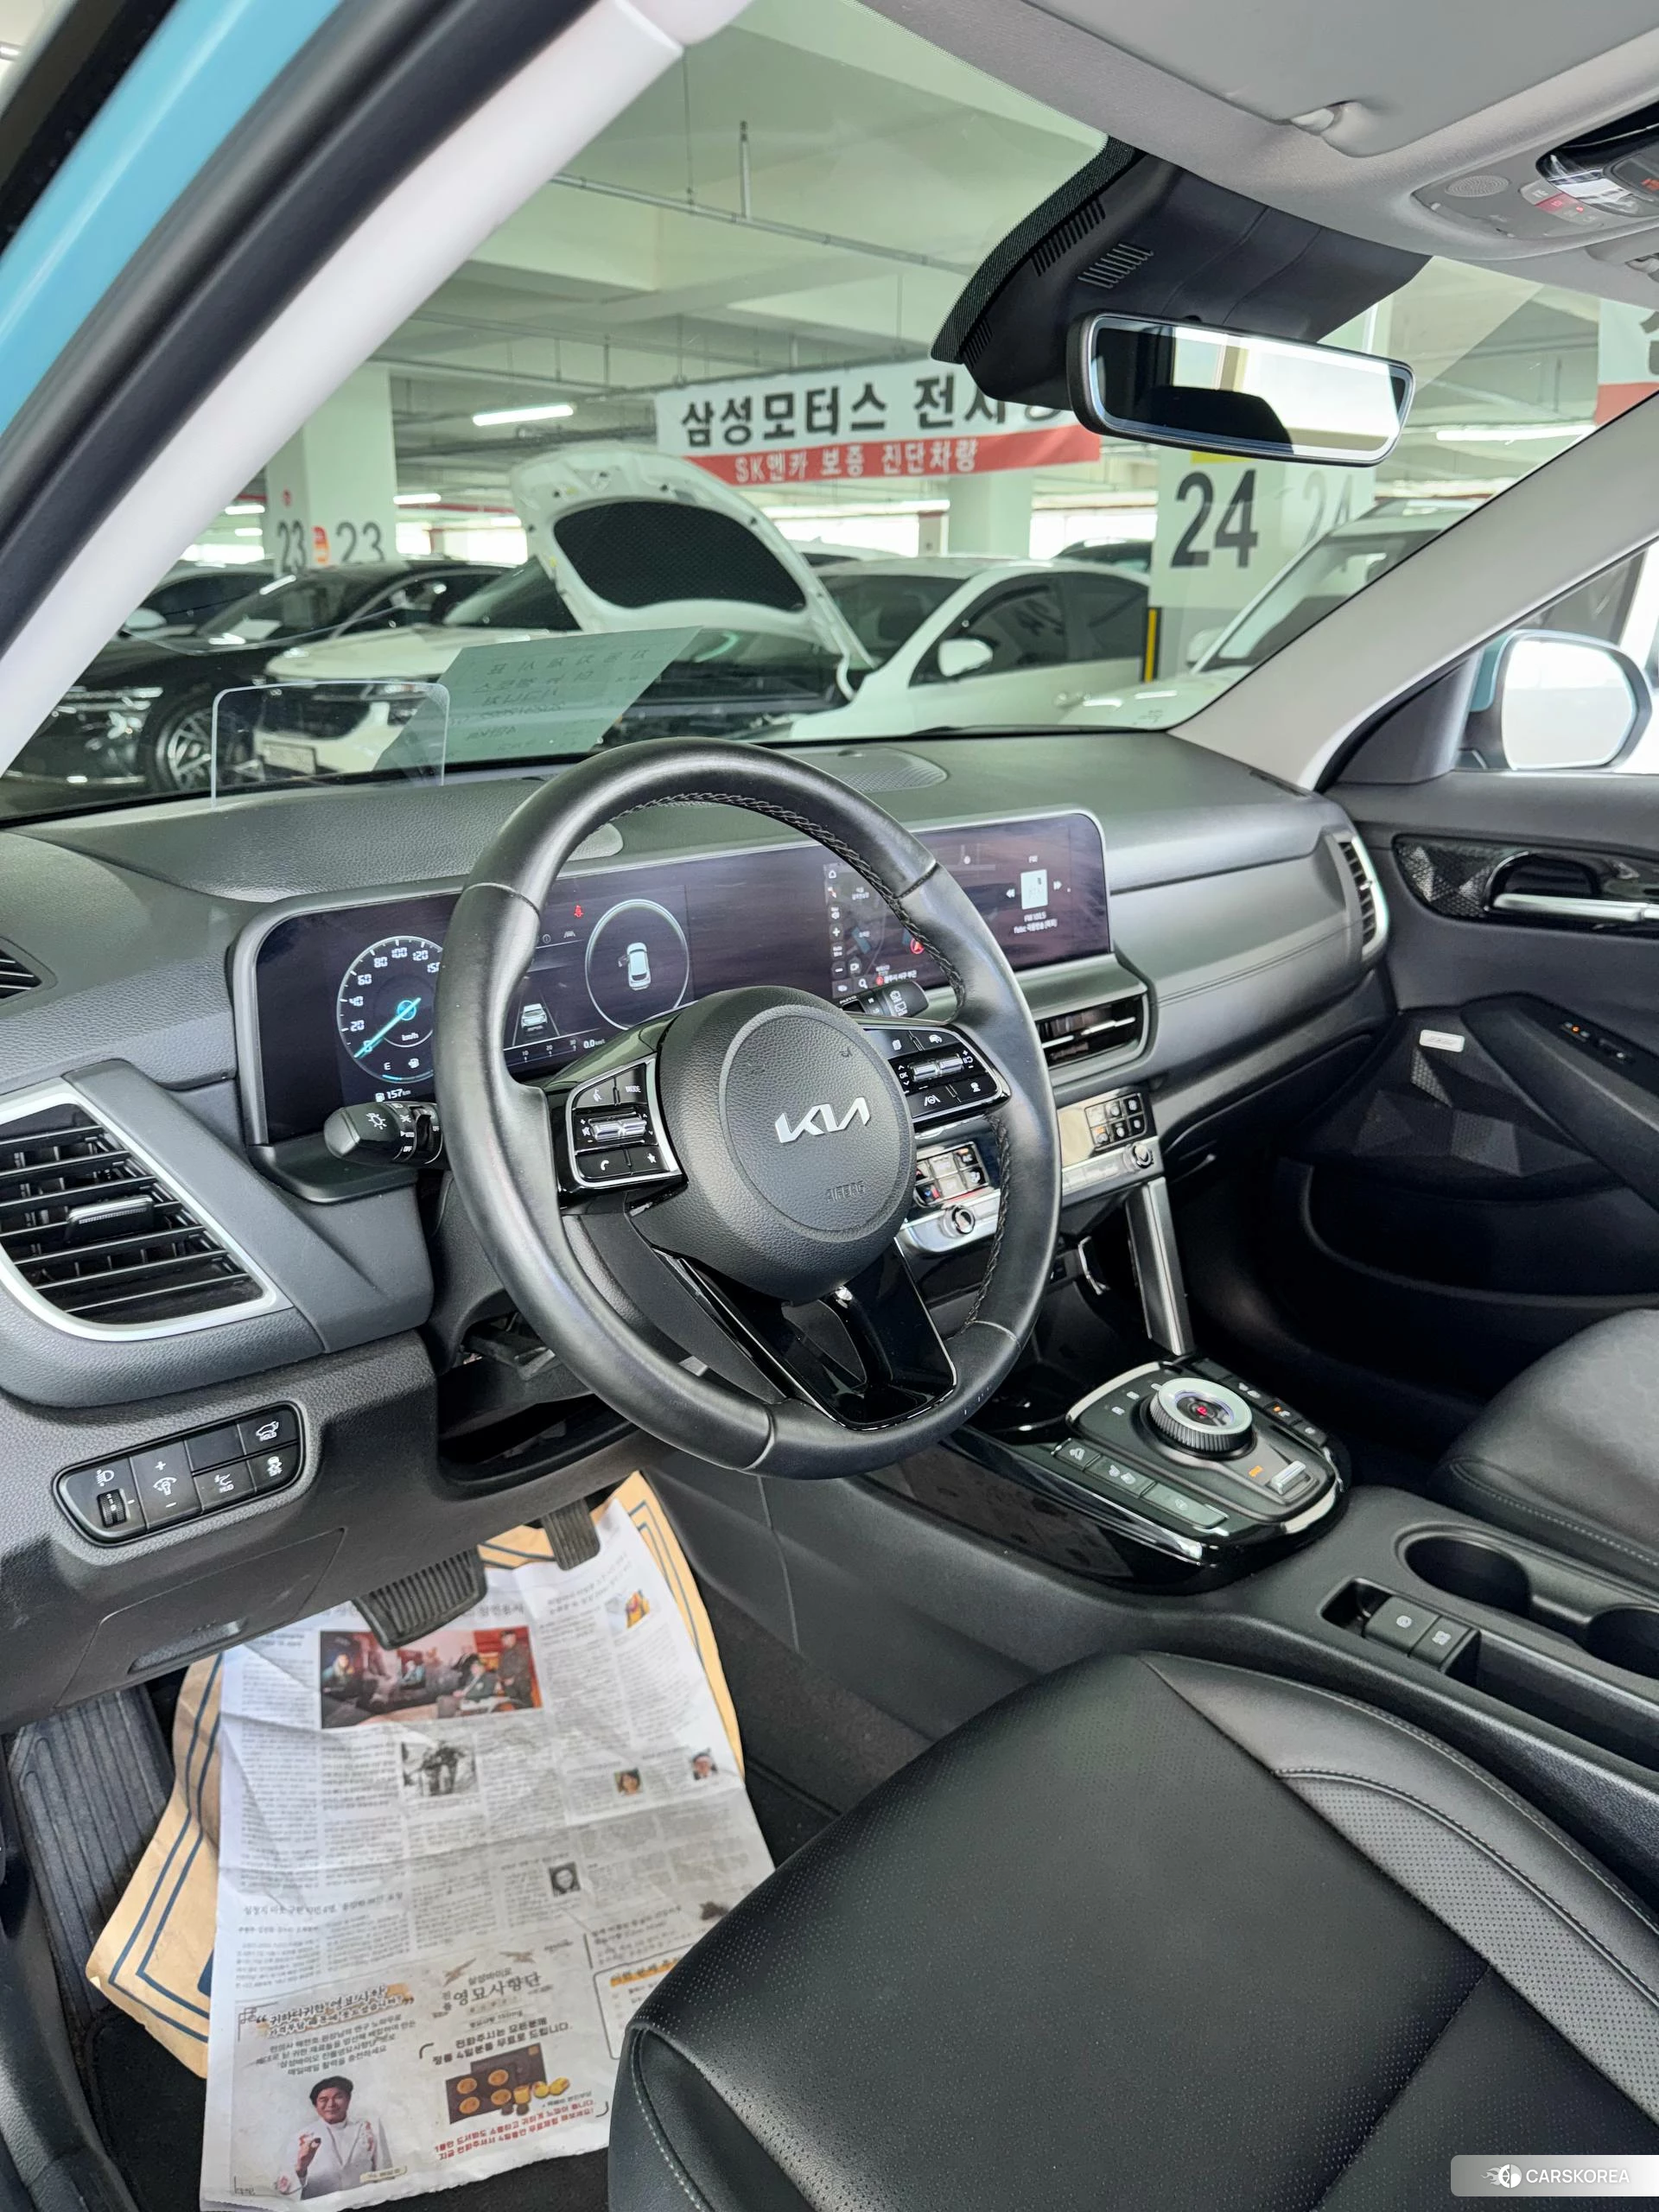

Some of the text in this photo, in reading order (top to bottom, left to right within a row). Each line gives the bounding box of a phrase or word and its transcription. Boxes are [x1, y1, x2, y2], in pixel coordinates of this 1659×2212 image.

[681, 372, 1062, 448] 삼성모터스 전시
[734, 436, 979, 484] SK엔카 보증 진단차량
[1170, 467, 1259, 570] 24
[335, 521, 386, 563] 23
[391, 947, 408, 958] 100
[412, 950, 429, 961] 120
[373, 957, 388, 968] 80
[358, 974, 372, 985] 60
[348, 995, 364, 1007] 40
[350, 1020, 365, 1032] 20
[384, 1062, 391, 1071] E
[775, 1096, 871, 1144] KIA
[453, 1971, 543, 2006] 영묘사향단
